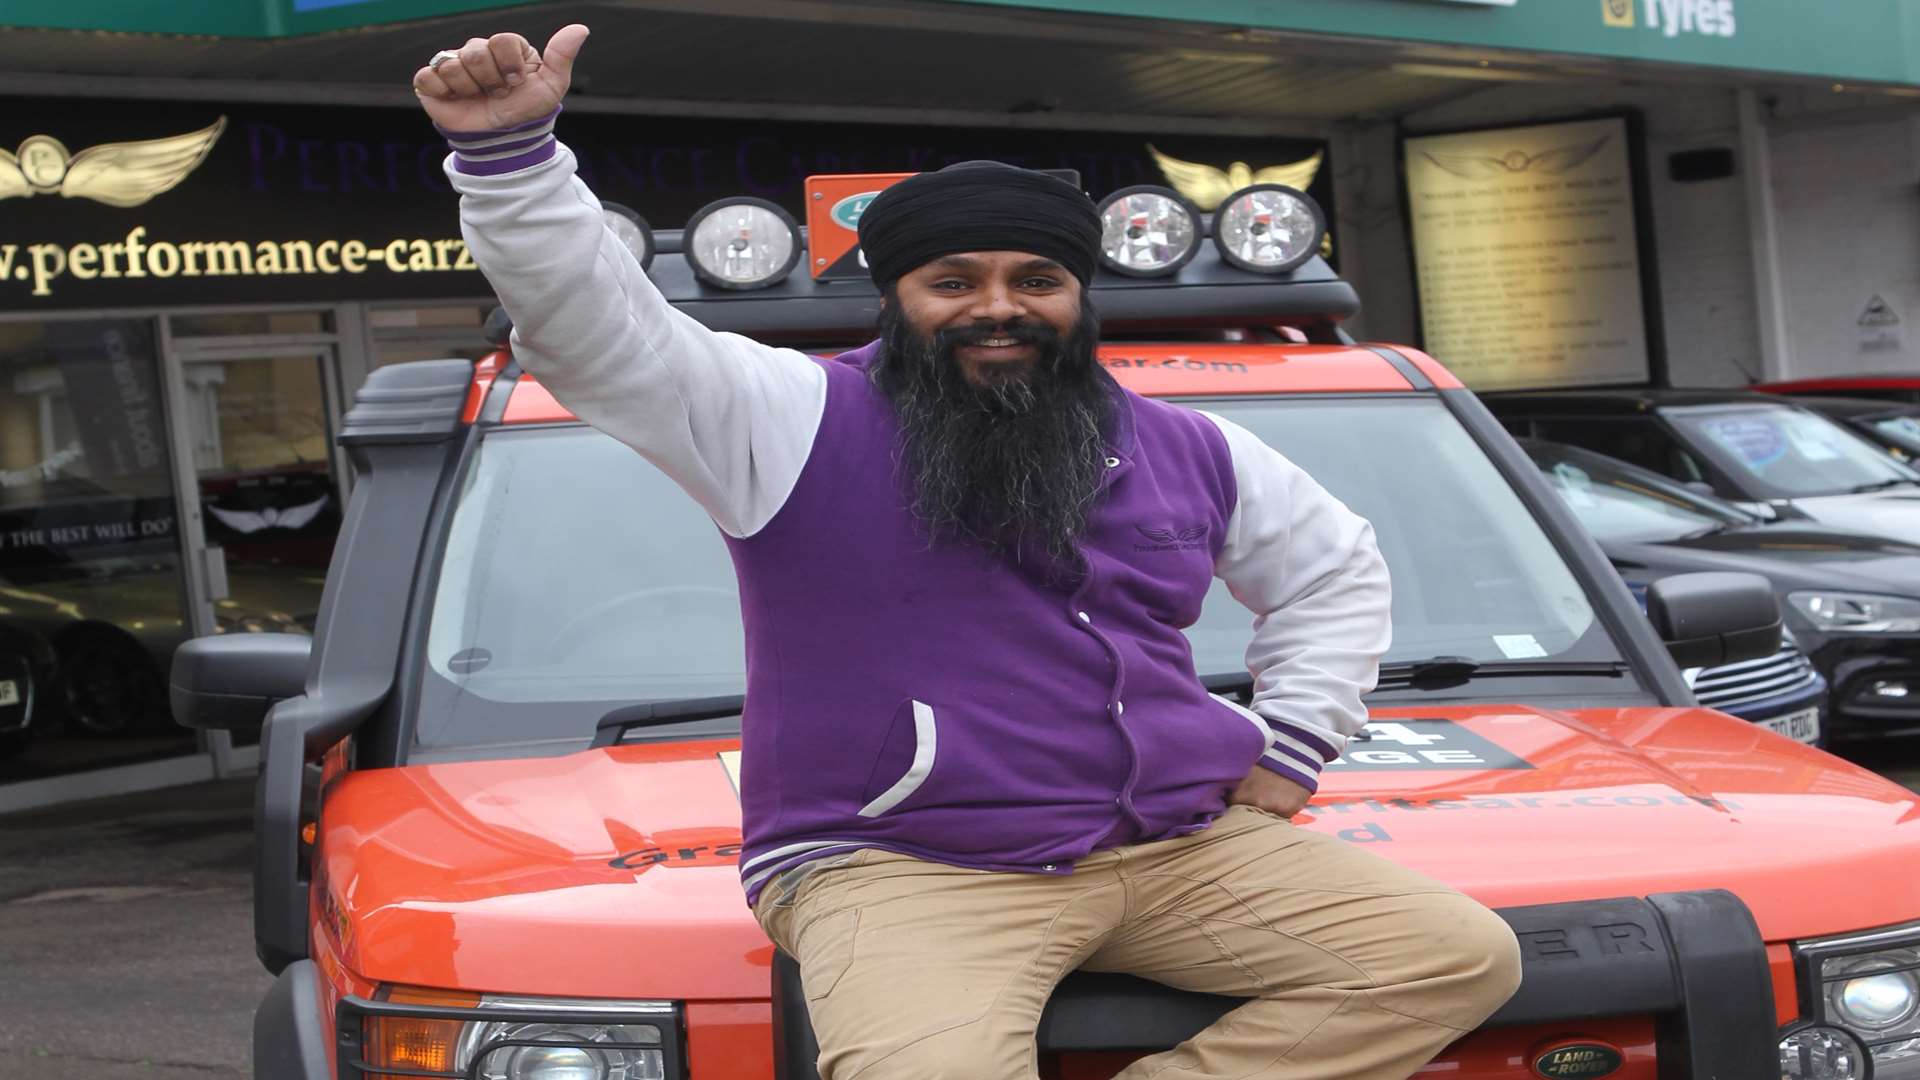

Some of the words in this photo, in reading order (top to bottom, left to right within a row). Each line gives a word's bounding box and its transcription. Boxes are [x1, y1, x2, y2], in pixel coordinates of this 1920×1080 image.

[11, 531, 46, 547] THE
[51, 525, 89, 543] BEST
[95, 521, 136, 538] WILL
